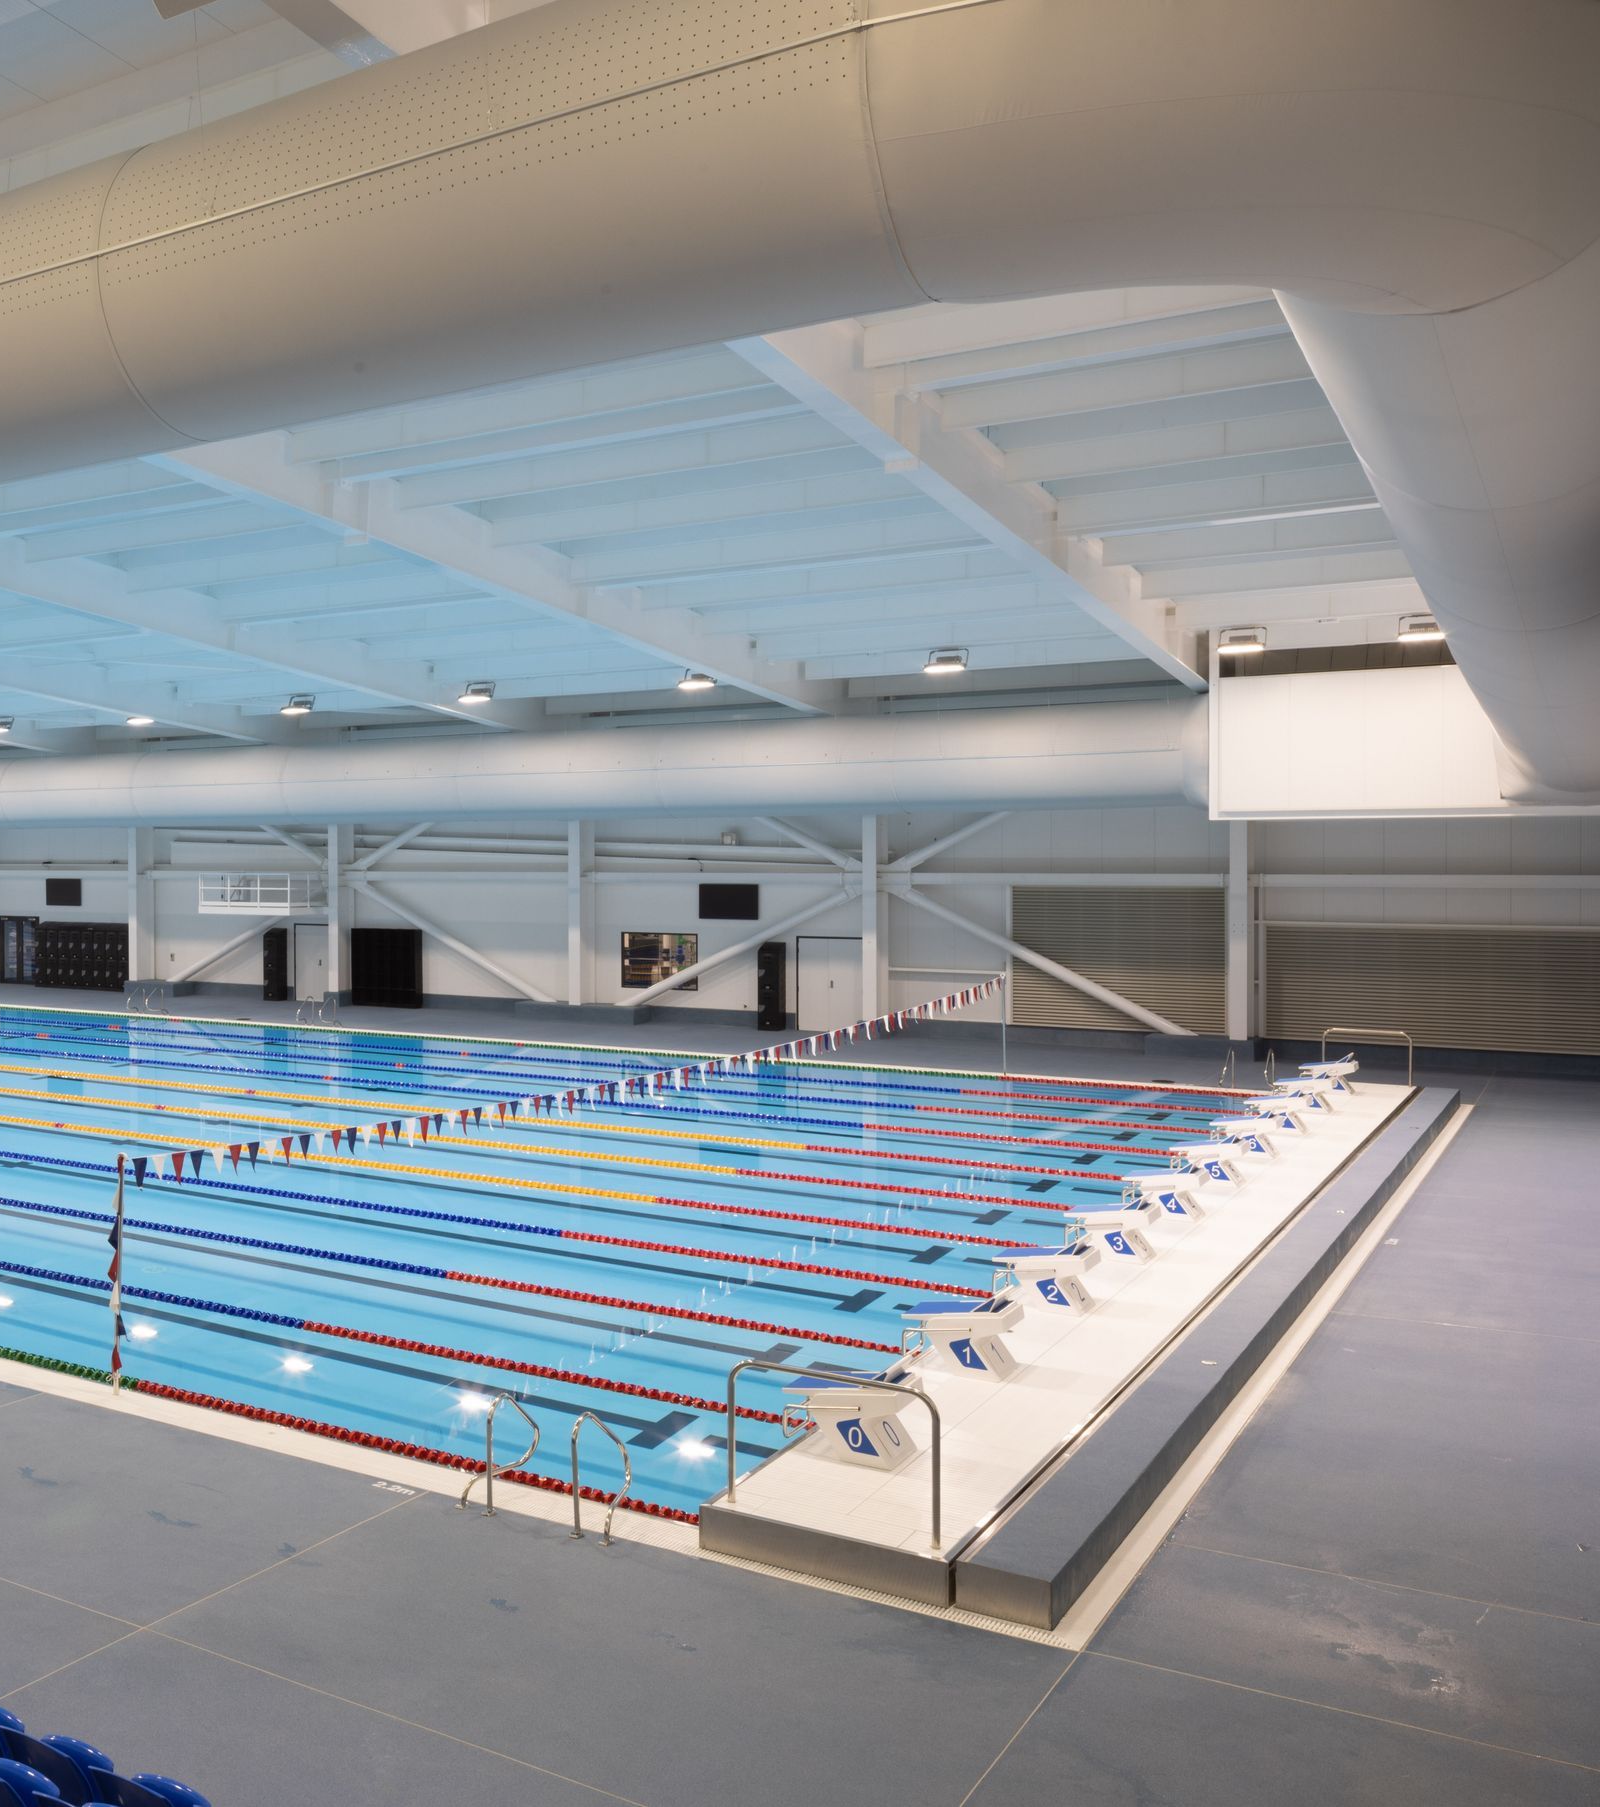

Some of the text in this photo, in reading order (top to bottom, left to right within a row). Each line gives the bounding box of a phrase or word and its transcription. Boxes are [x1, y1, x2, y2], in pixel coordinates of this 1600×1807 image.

[1249, 1138, 1257, 1150] 6
[1211, 1165, 1220, 1178] 5
[1166, 1198, 1177, 1211] 4
[1113, 1236, 1124, 1252] 3
[1046, 1284, 1059, 1302] 2
[1071, 1282, 1086, 1302] 2
[962, 1346, 971, 1364] 1
[848, 1426, 863, 1448] 0
[882, 1420, 901, 1447] 0
[371, 1480, 417, 1496] 2.2m
